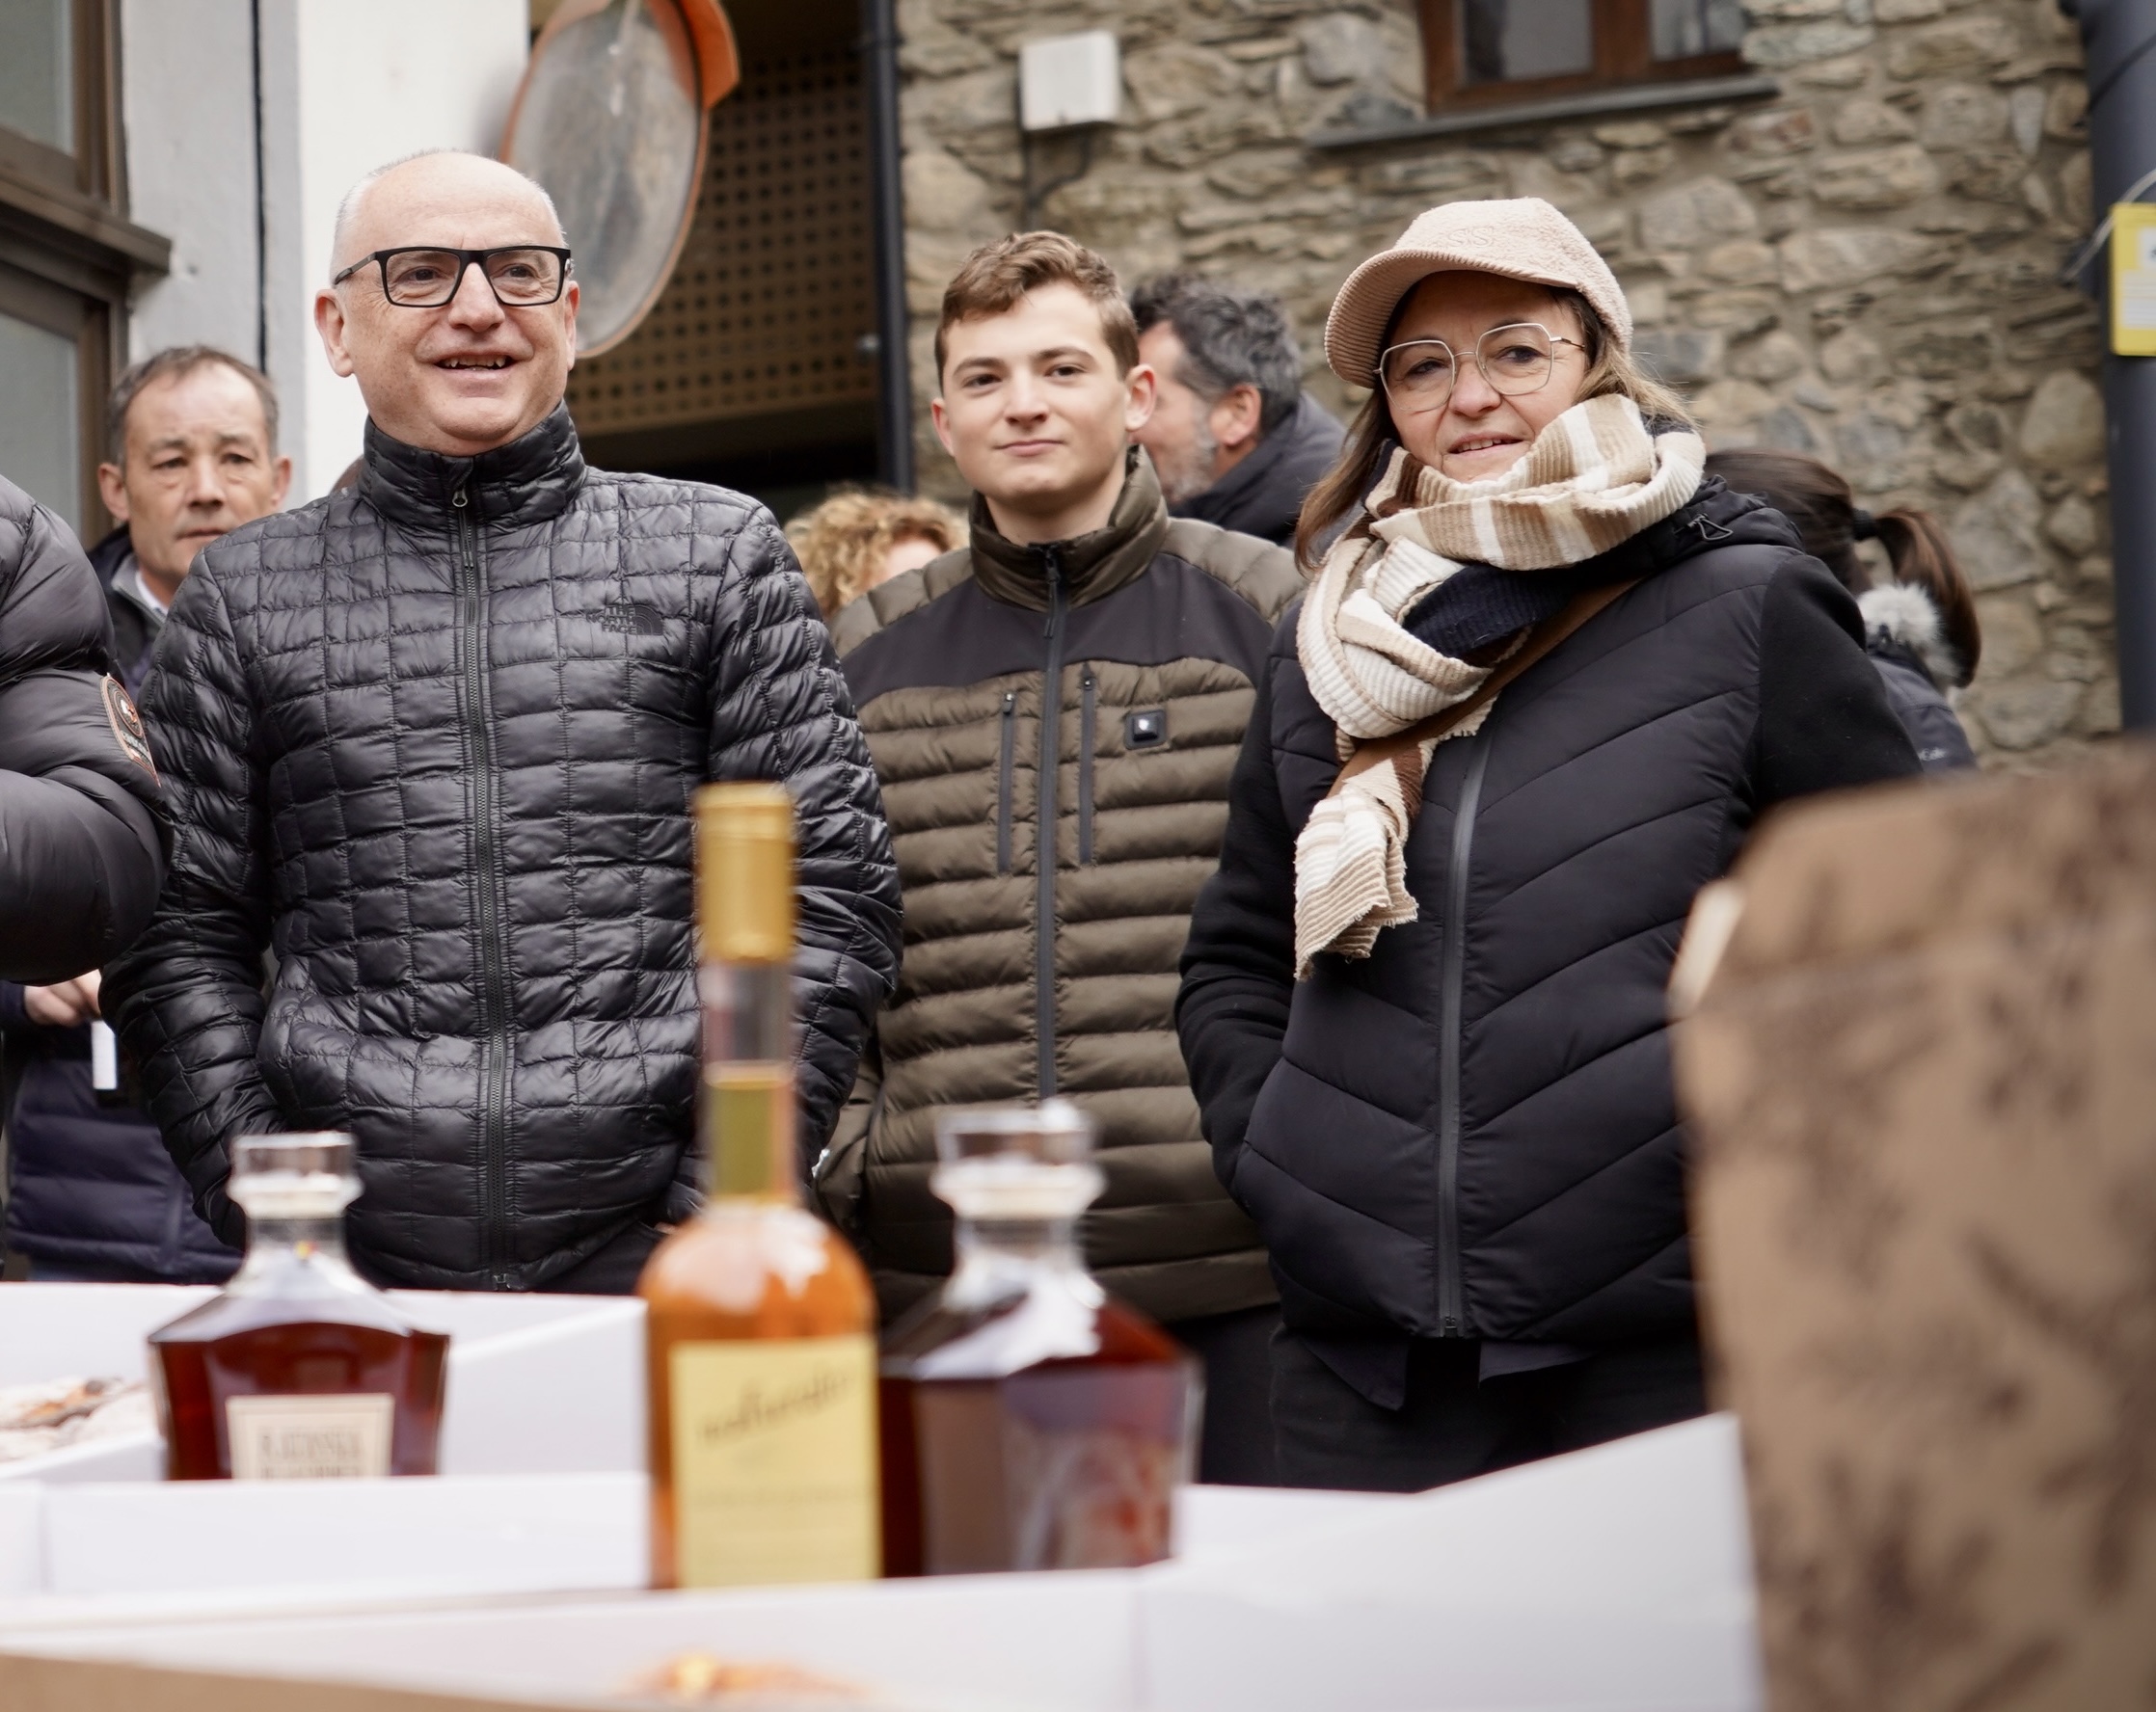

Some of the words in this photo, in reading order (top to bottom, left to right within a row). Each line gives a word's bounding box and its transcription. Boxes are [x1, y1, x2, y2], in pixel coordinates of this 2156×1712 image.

[605, 605, 635, 617] THE
[586, 613, 636, 626] NORTH
[602, 624, 636, 635] FACE
